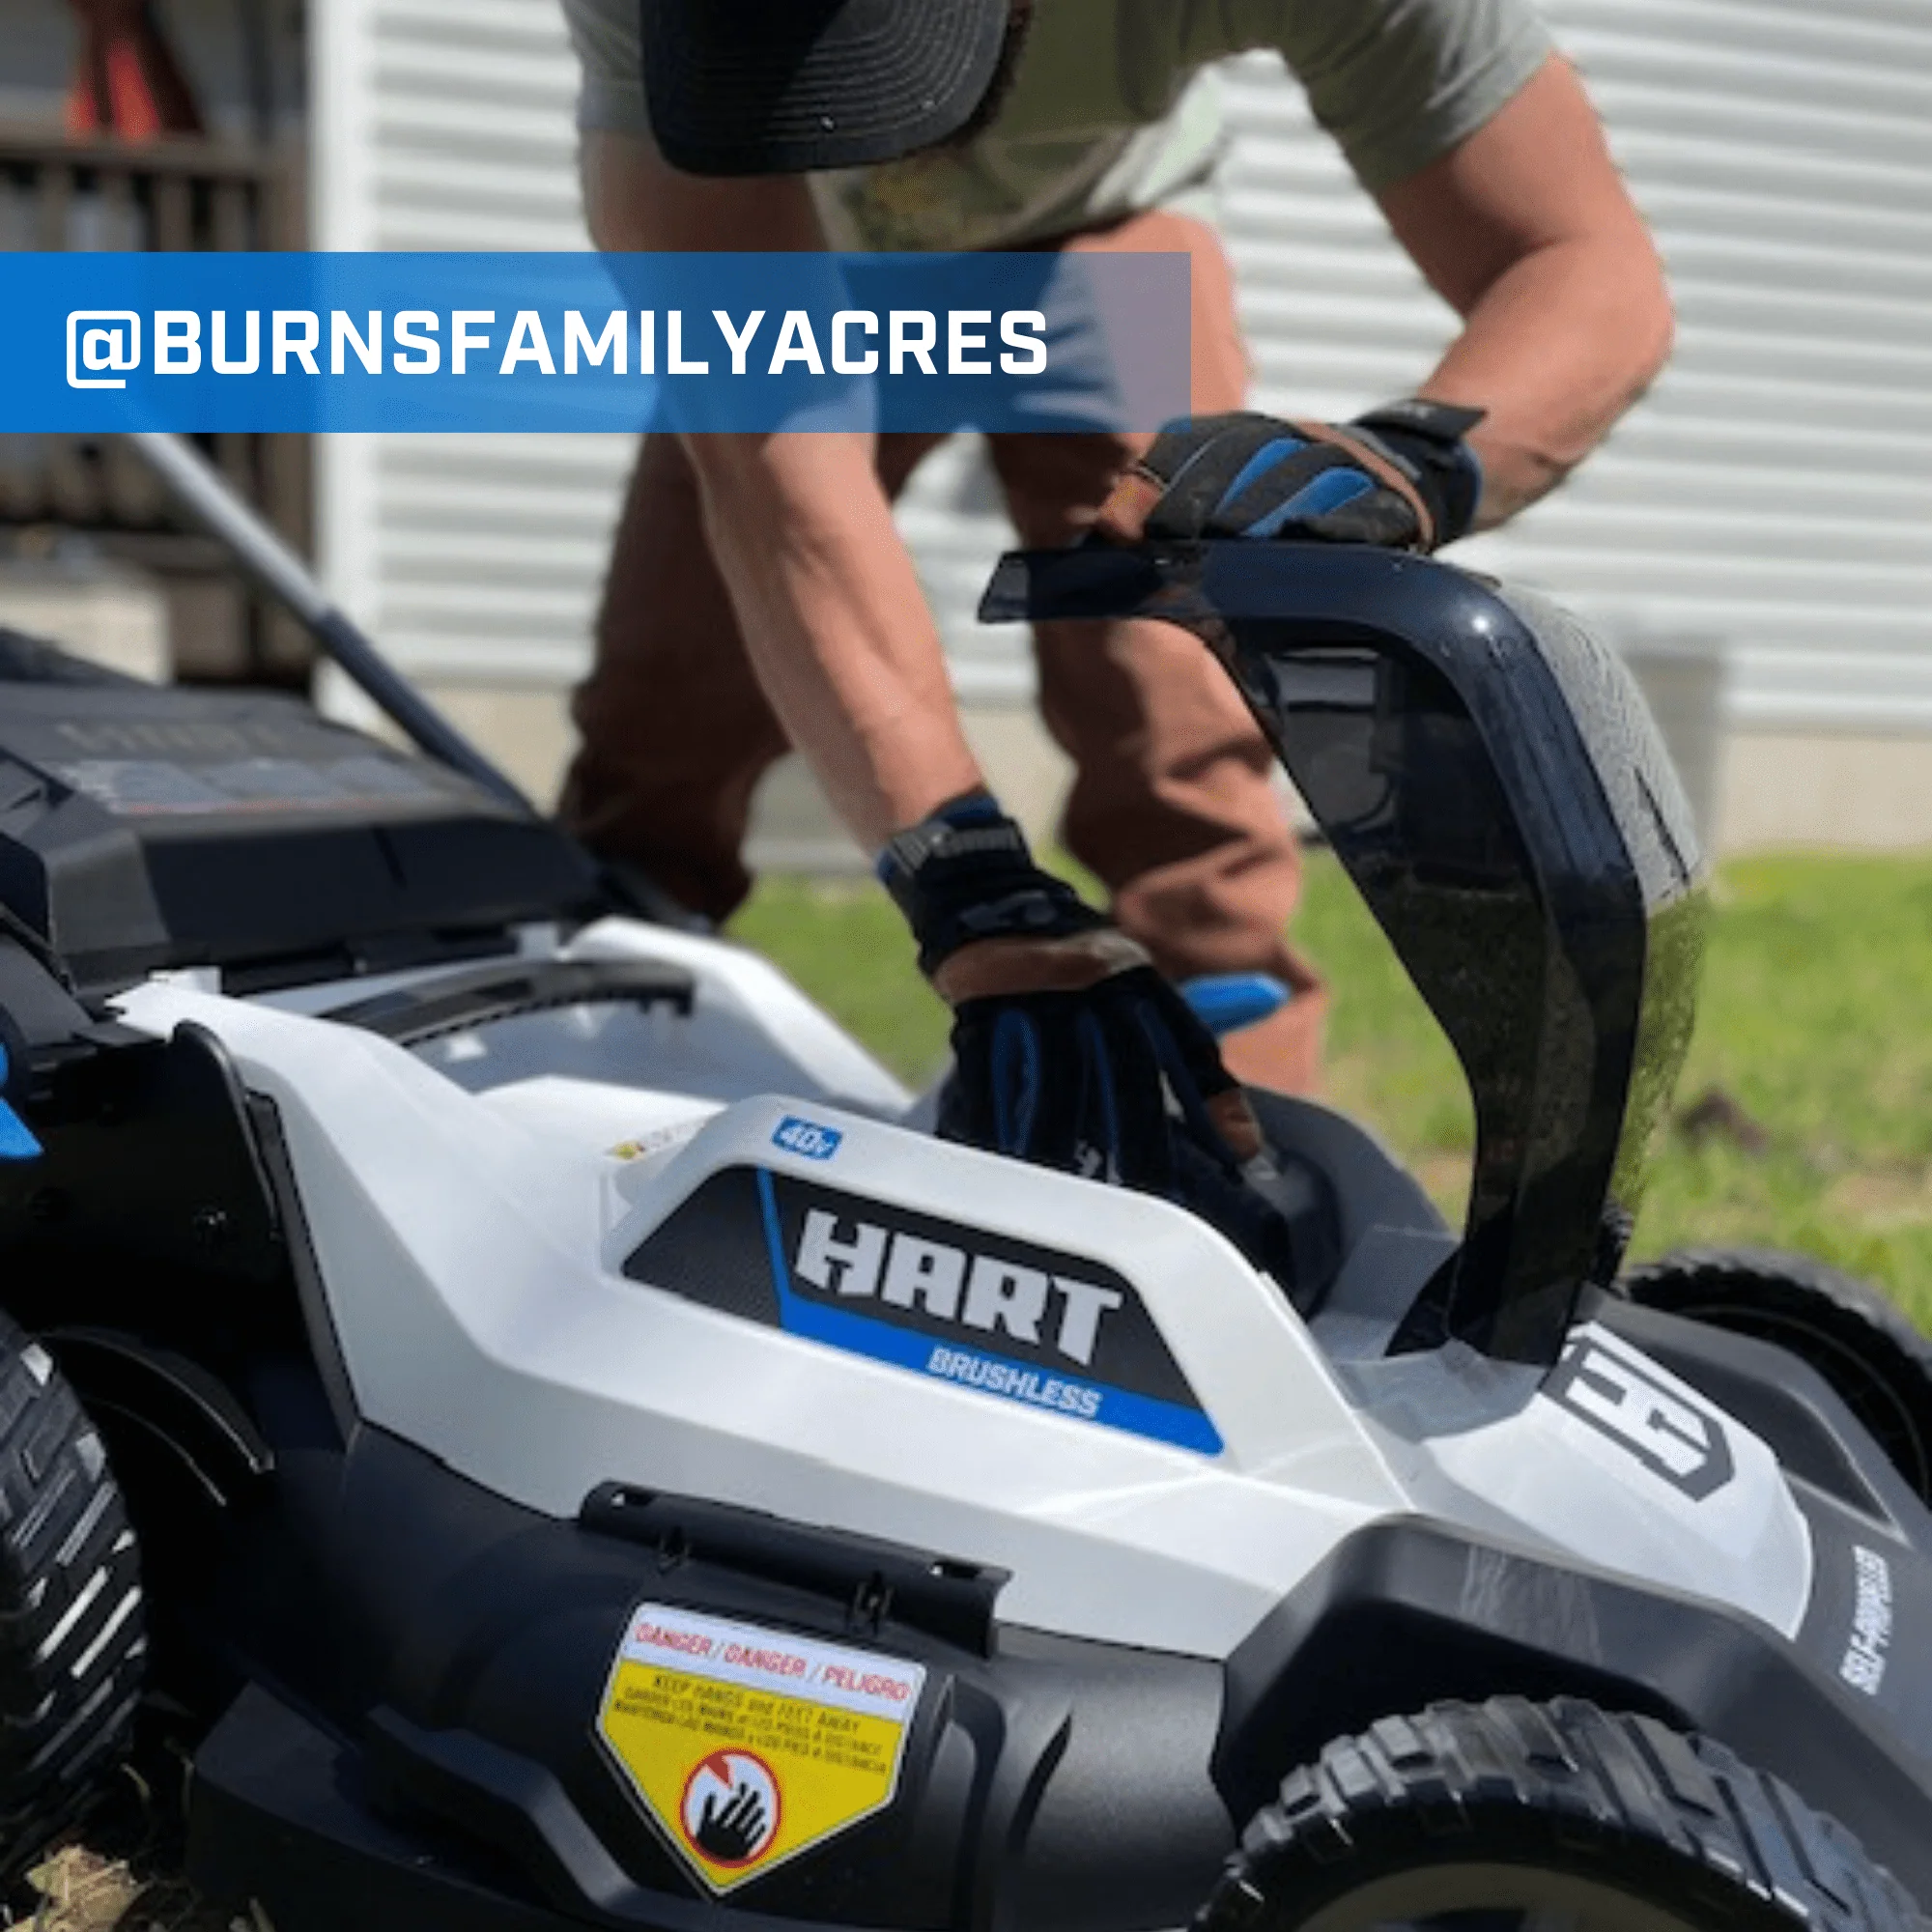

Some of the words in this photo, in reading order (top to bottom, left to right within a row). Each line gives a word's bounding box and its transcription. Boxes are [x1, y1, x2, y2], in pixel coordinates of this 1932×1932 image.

[794, 1208, 1123, 1365] HART
[924, 1345, 1103, 1420] BRUSHLESS
[633, 1623, 713, 1655] DANGER
[723, 1644, 808, 1678] DANGER
[823, 1664, 912, 1701] PELIGRO
